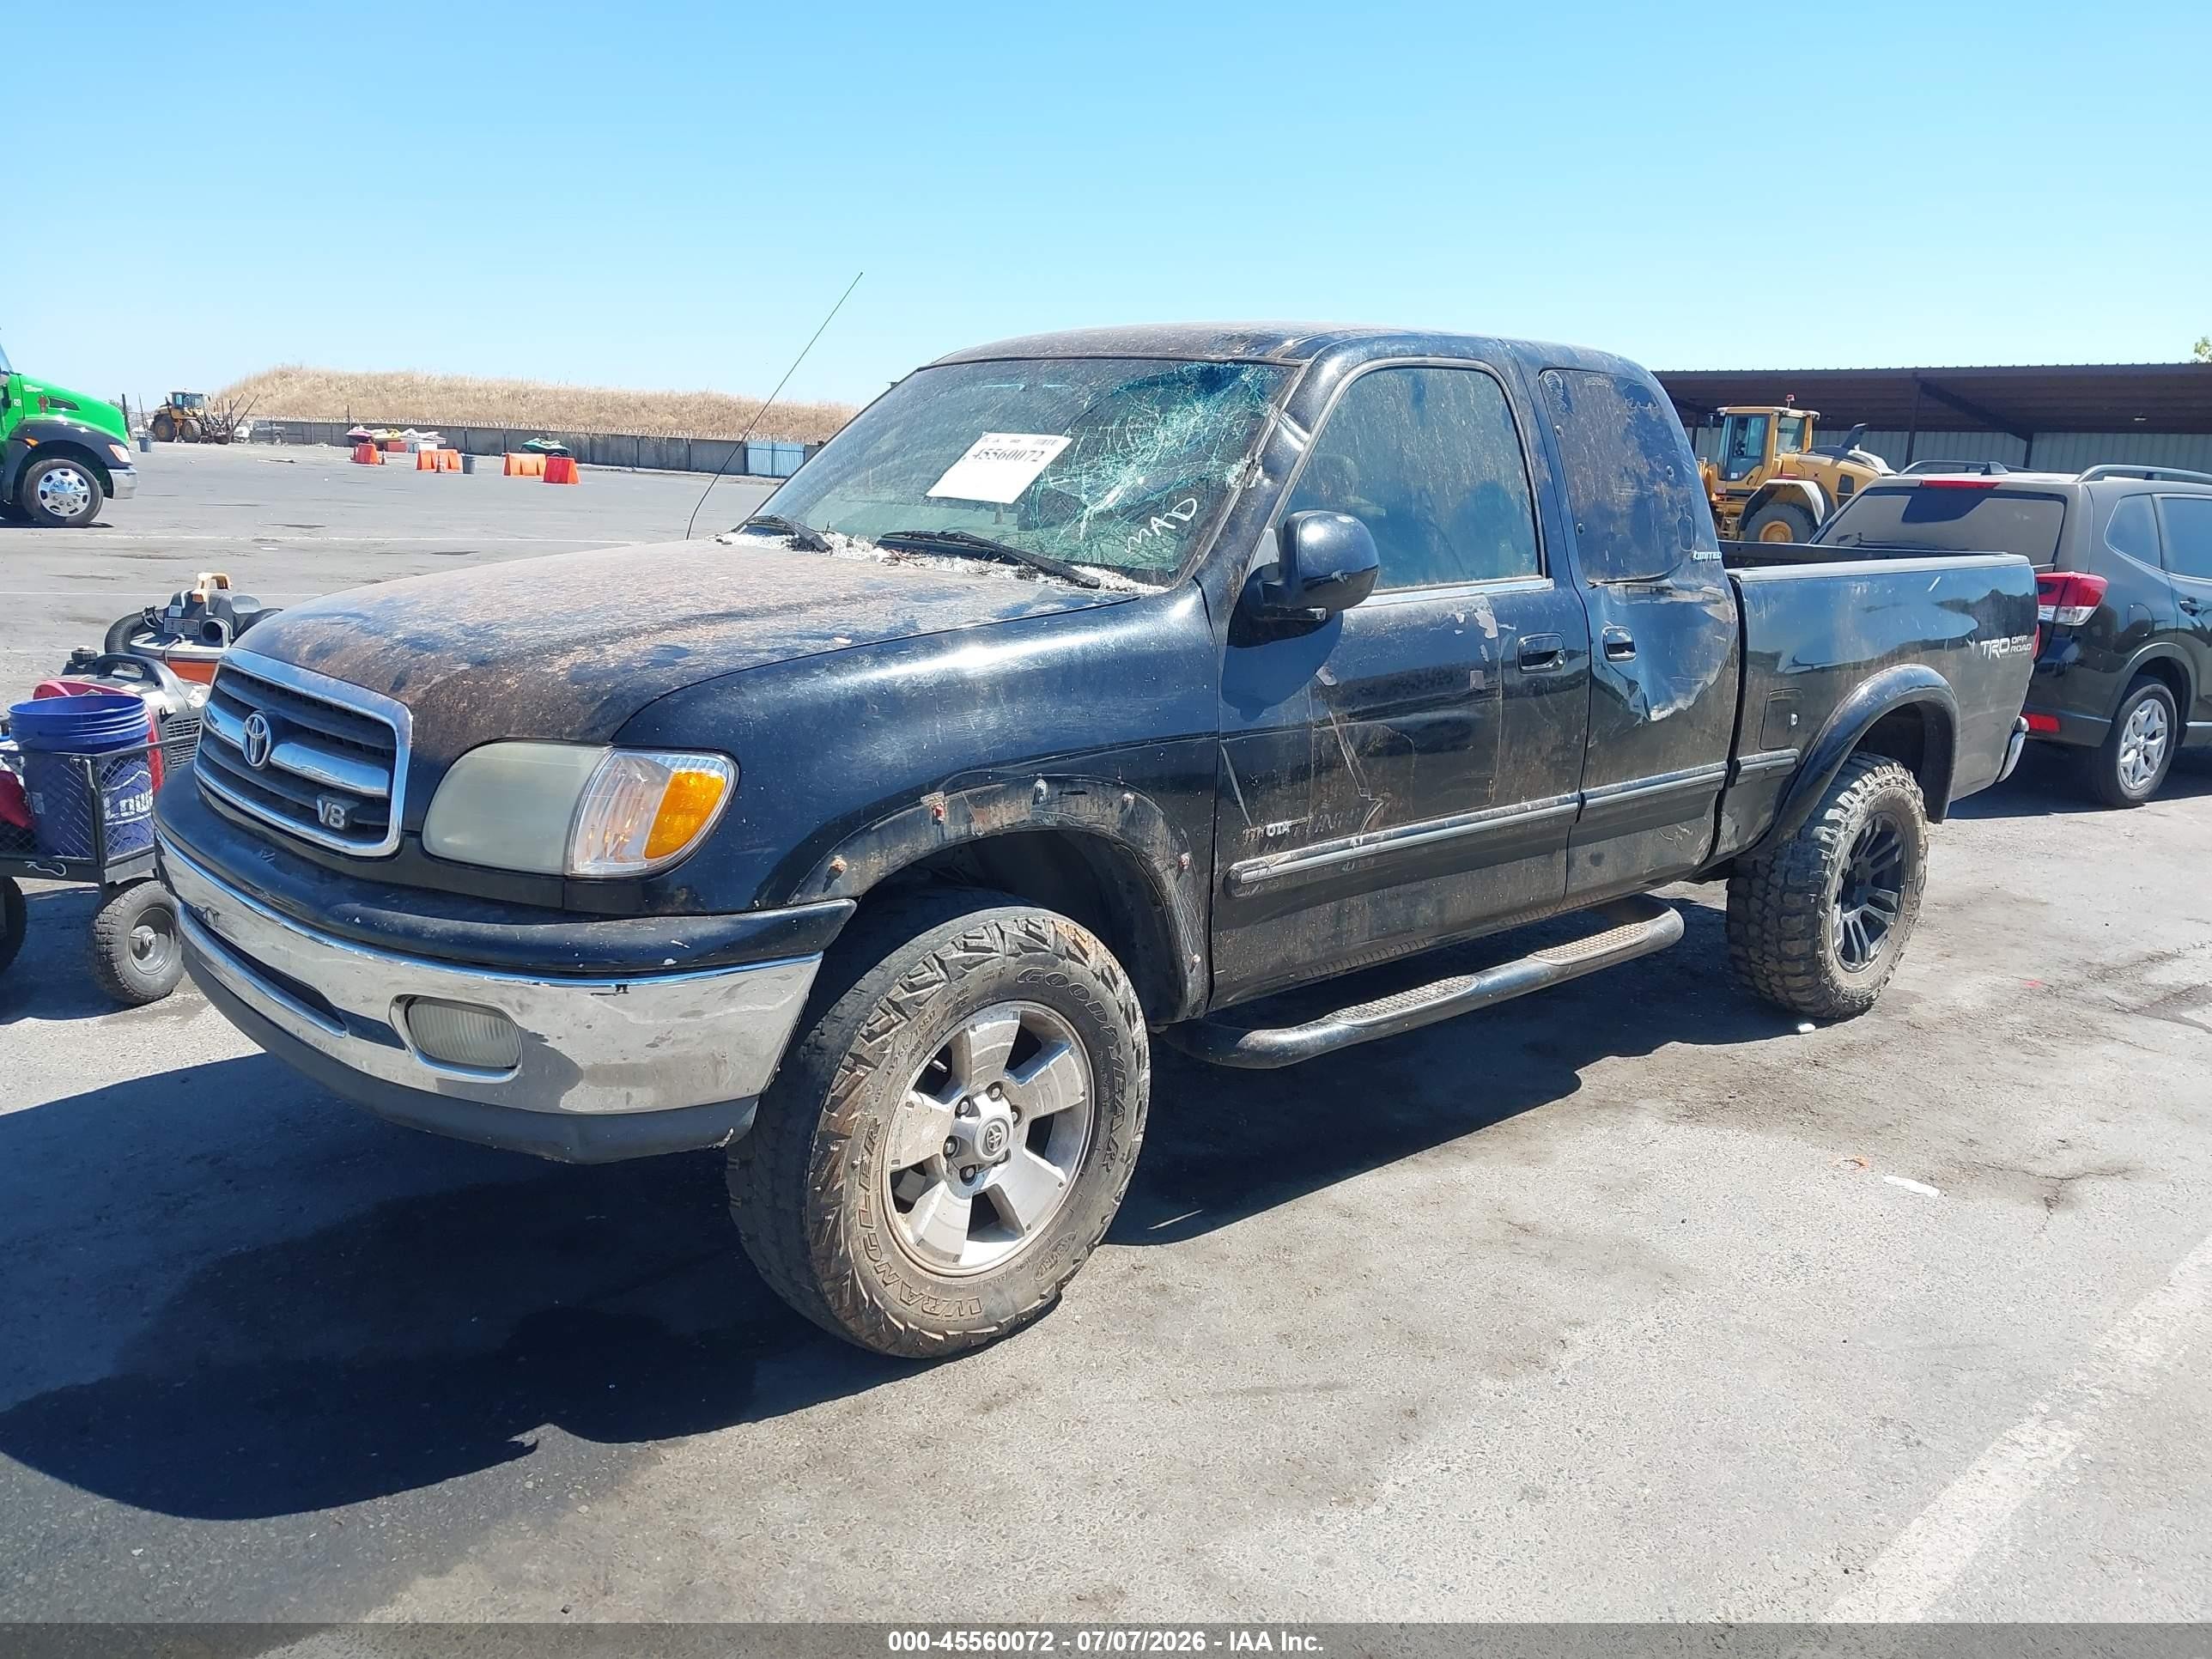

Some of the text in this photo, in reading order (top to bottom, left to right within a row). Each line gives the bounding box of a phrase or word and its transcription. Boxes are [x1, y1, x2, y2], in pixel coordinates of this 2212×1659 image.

[972, 448, 1045, 463] 45560072
[1980, 637, 2011, 660] TRD
[2010, 643, 2033, 653] ROAD
[2011, 635, 2027, 645] OFF
[316, 798, 345, 830] V8
[1016, 967, 1127, 1174] GOODYEAR
[858, 1116, 984, 1317] WRANGLER
